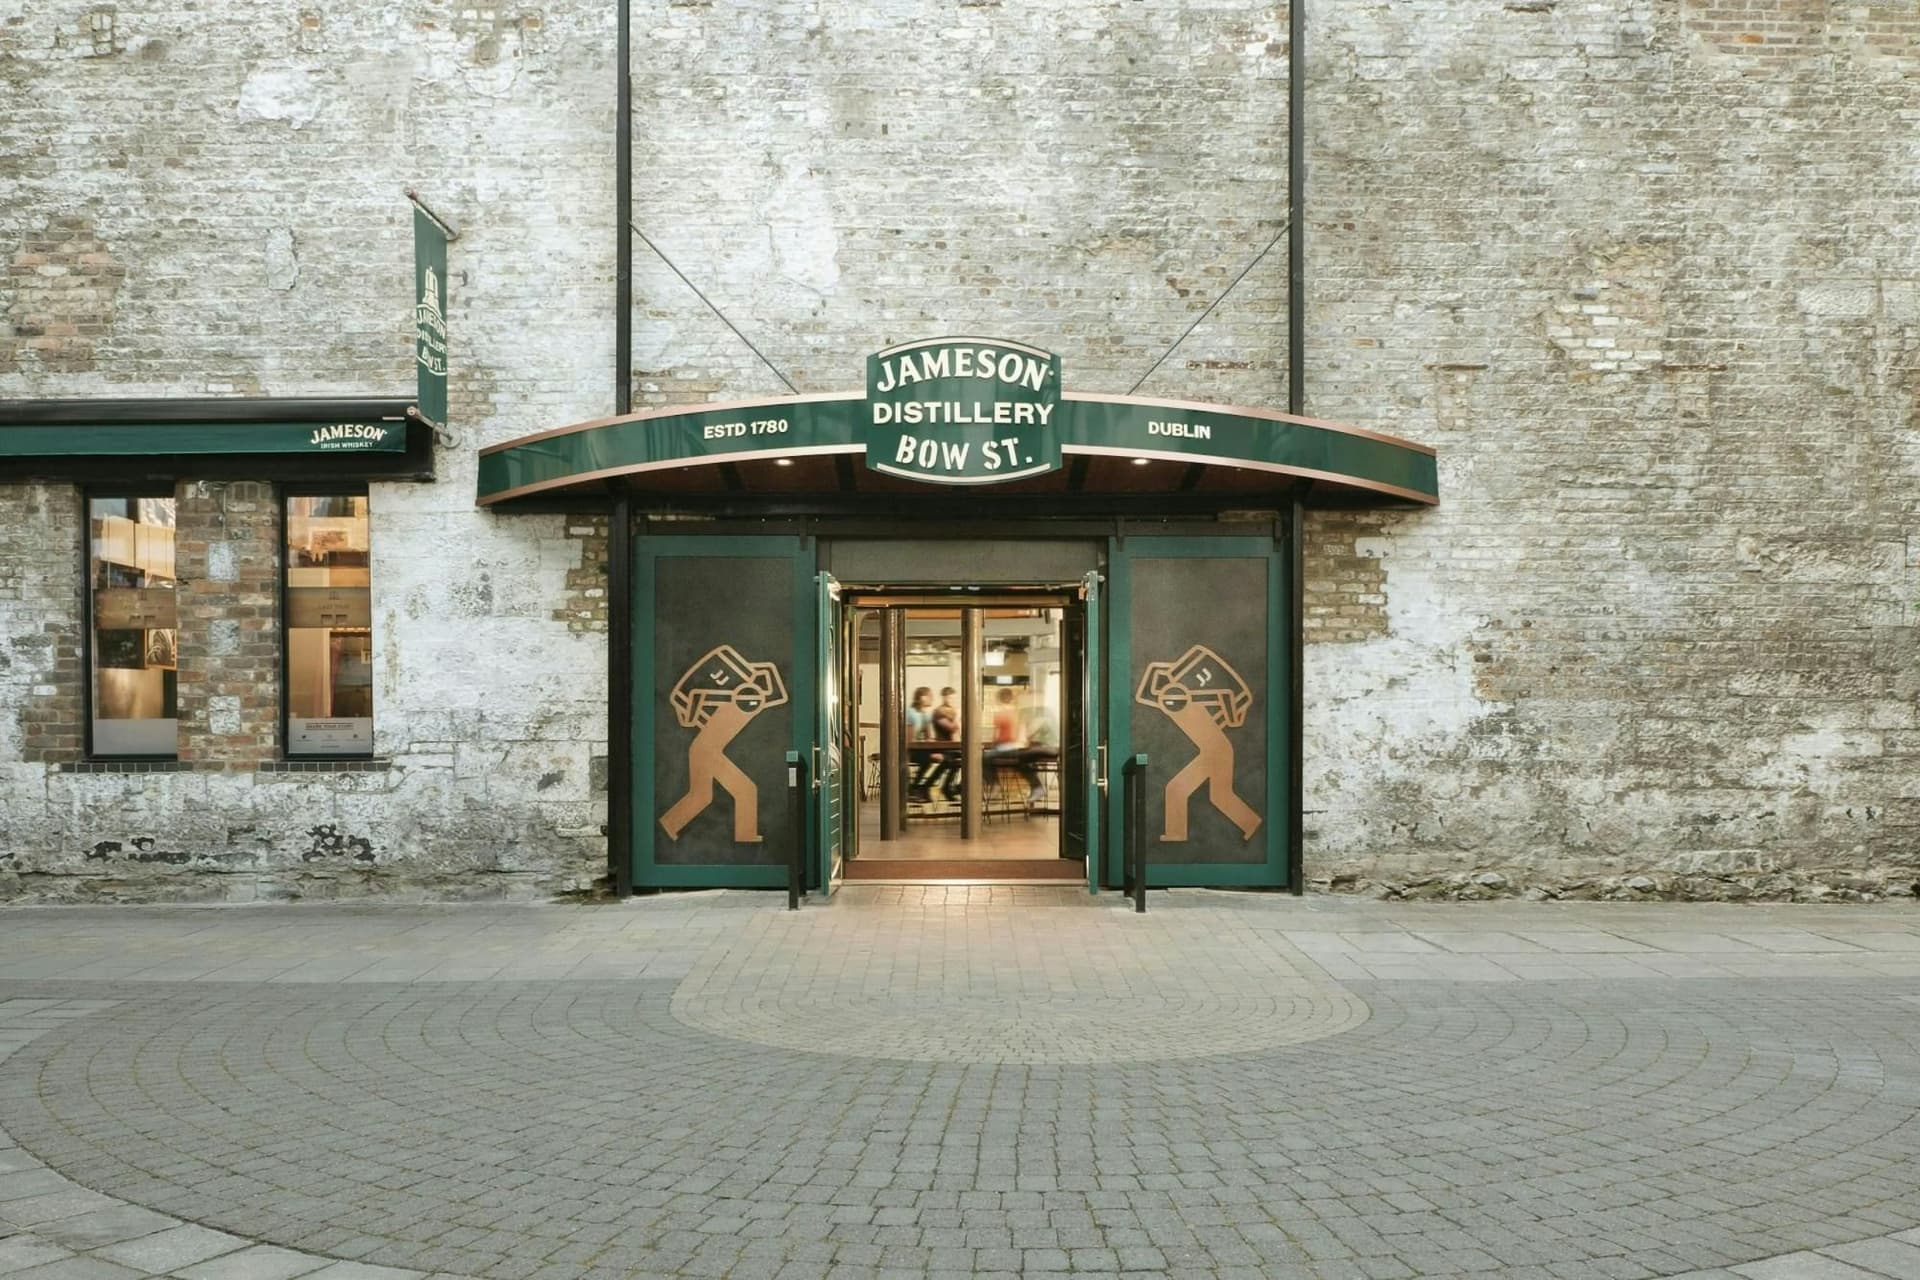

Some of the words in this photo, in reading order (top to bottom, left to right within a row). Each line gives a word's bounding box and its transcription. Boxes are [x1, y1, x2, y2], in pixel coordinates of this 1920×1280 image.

[417, 328, 448, 354] DISLLERY
[421, 346, 434, 368] BW
[877, 348, 1048, 392] JAMESON
[873, 402, 1054, 425] DISTILLERY
[310, 424, 384, 444] JAMESON
[704, 423, 746, 439] ESTD
[750, 419, 788, 435] 1780
[1147, 421, 1211, 439] DUBLIN
[896, 434, 969, 470] BOW
[982, 437, 1033, 470] ST.
